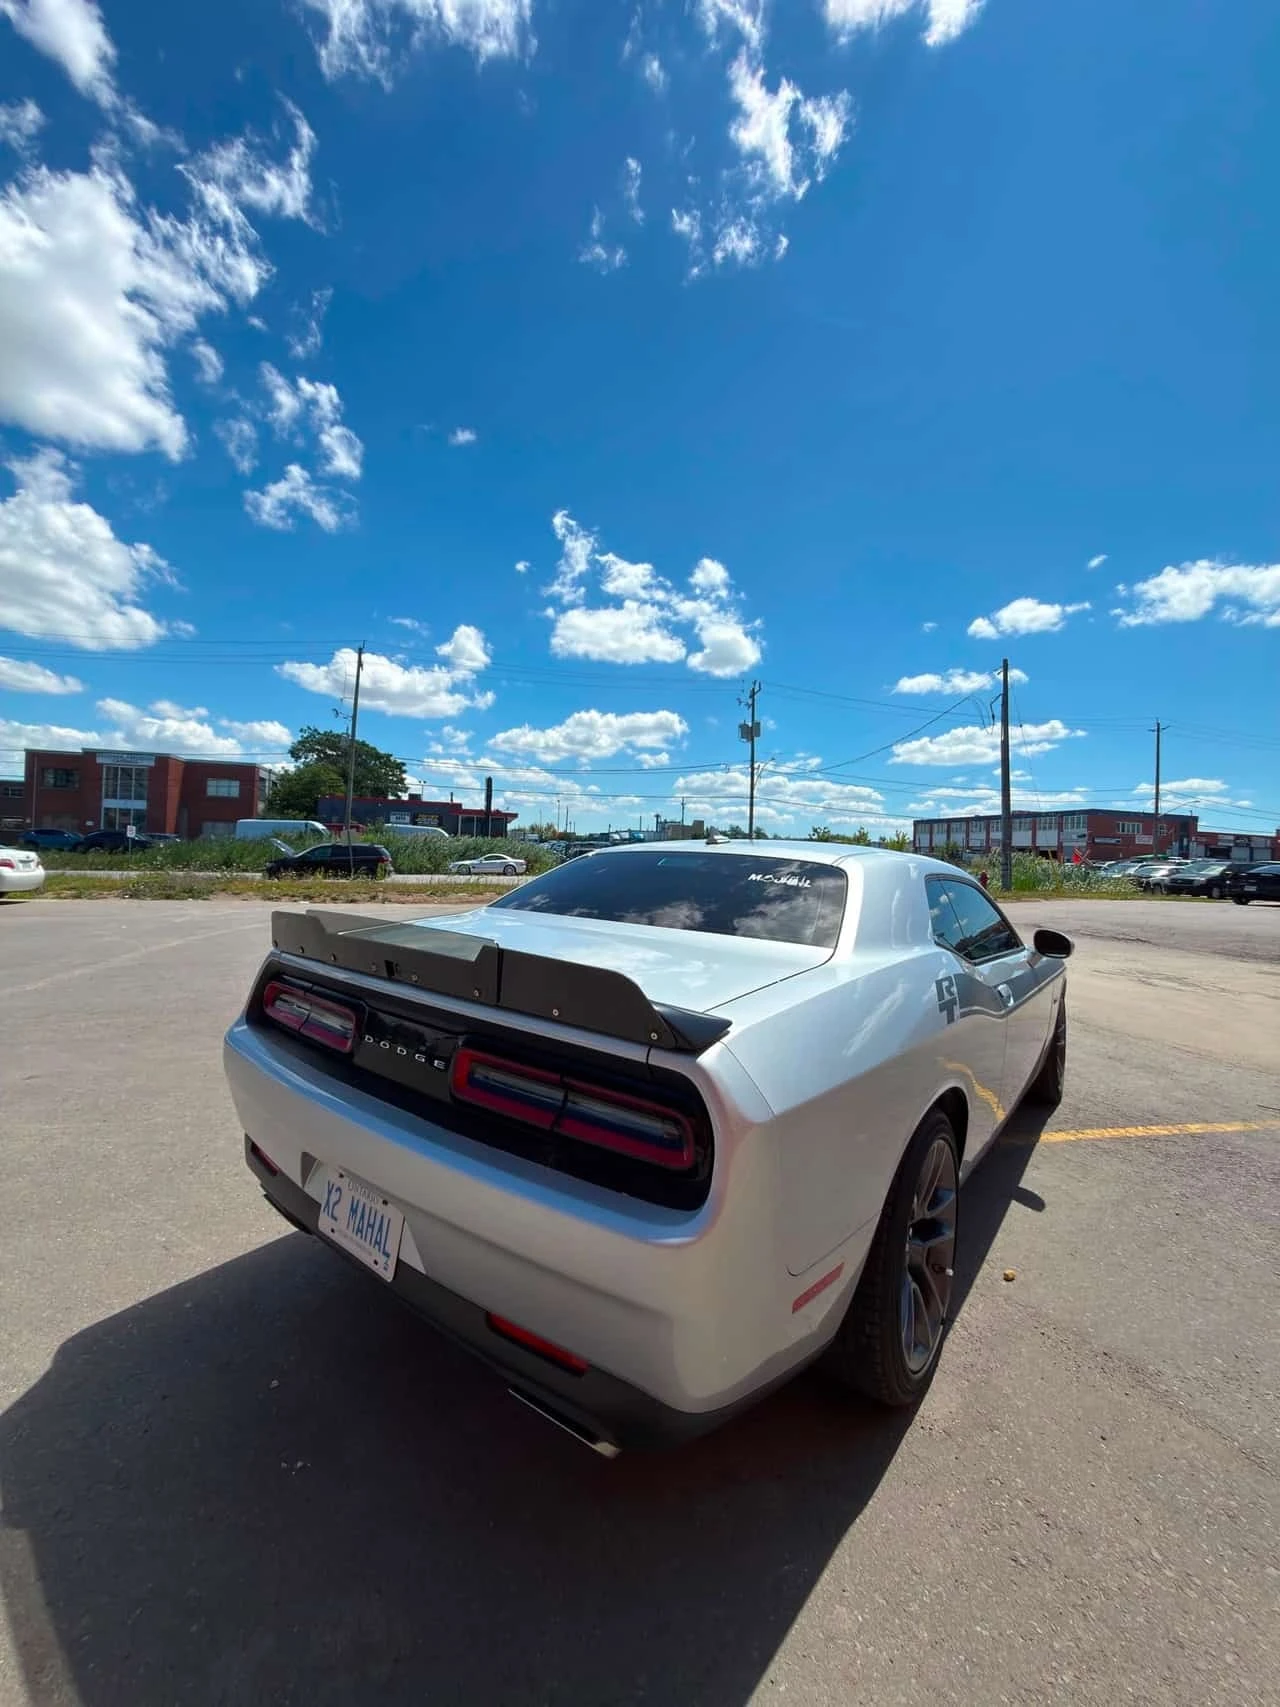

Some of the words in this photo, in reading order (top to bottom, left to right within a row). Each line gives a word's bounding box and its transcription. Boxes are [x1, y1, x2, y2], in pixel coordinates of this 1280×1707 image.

[364, 1034, 446, 1069] DODGE
[322, 1180, 342, 1222] X2
[346, 1195, 391, 1258] MAHAL
